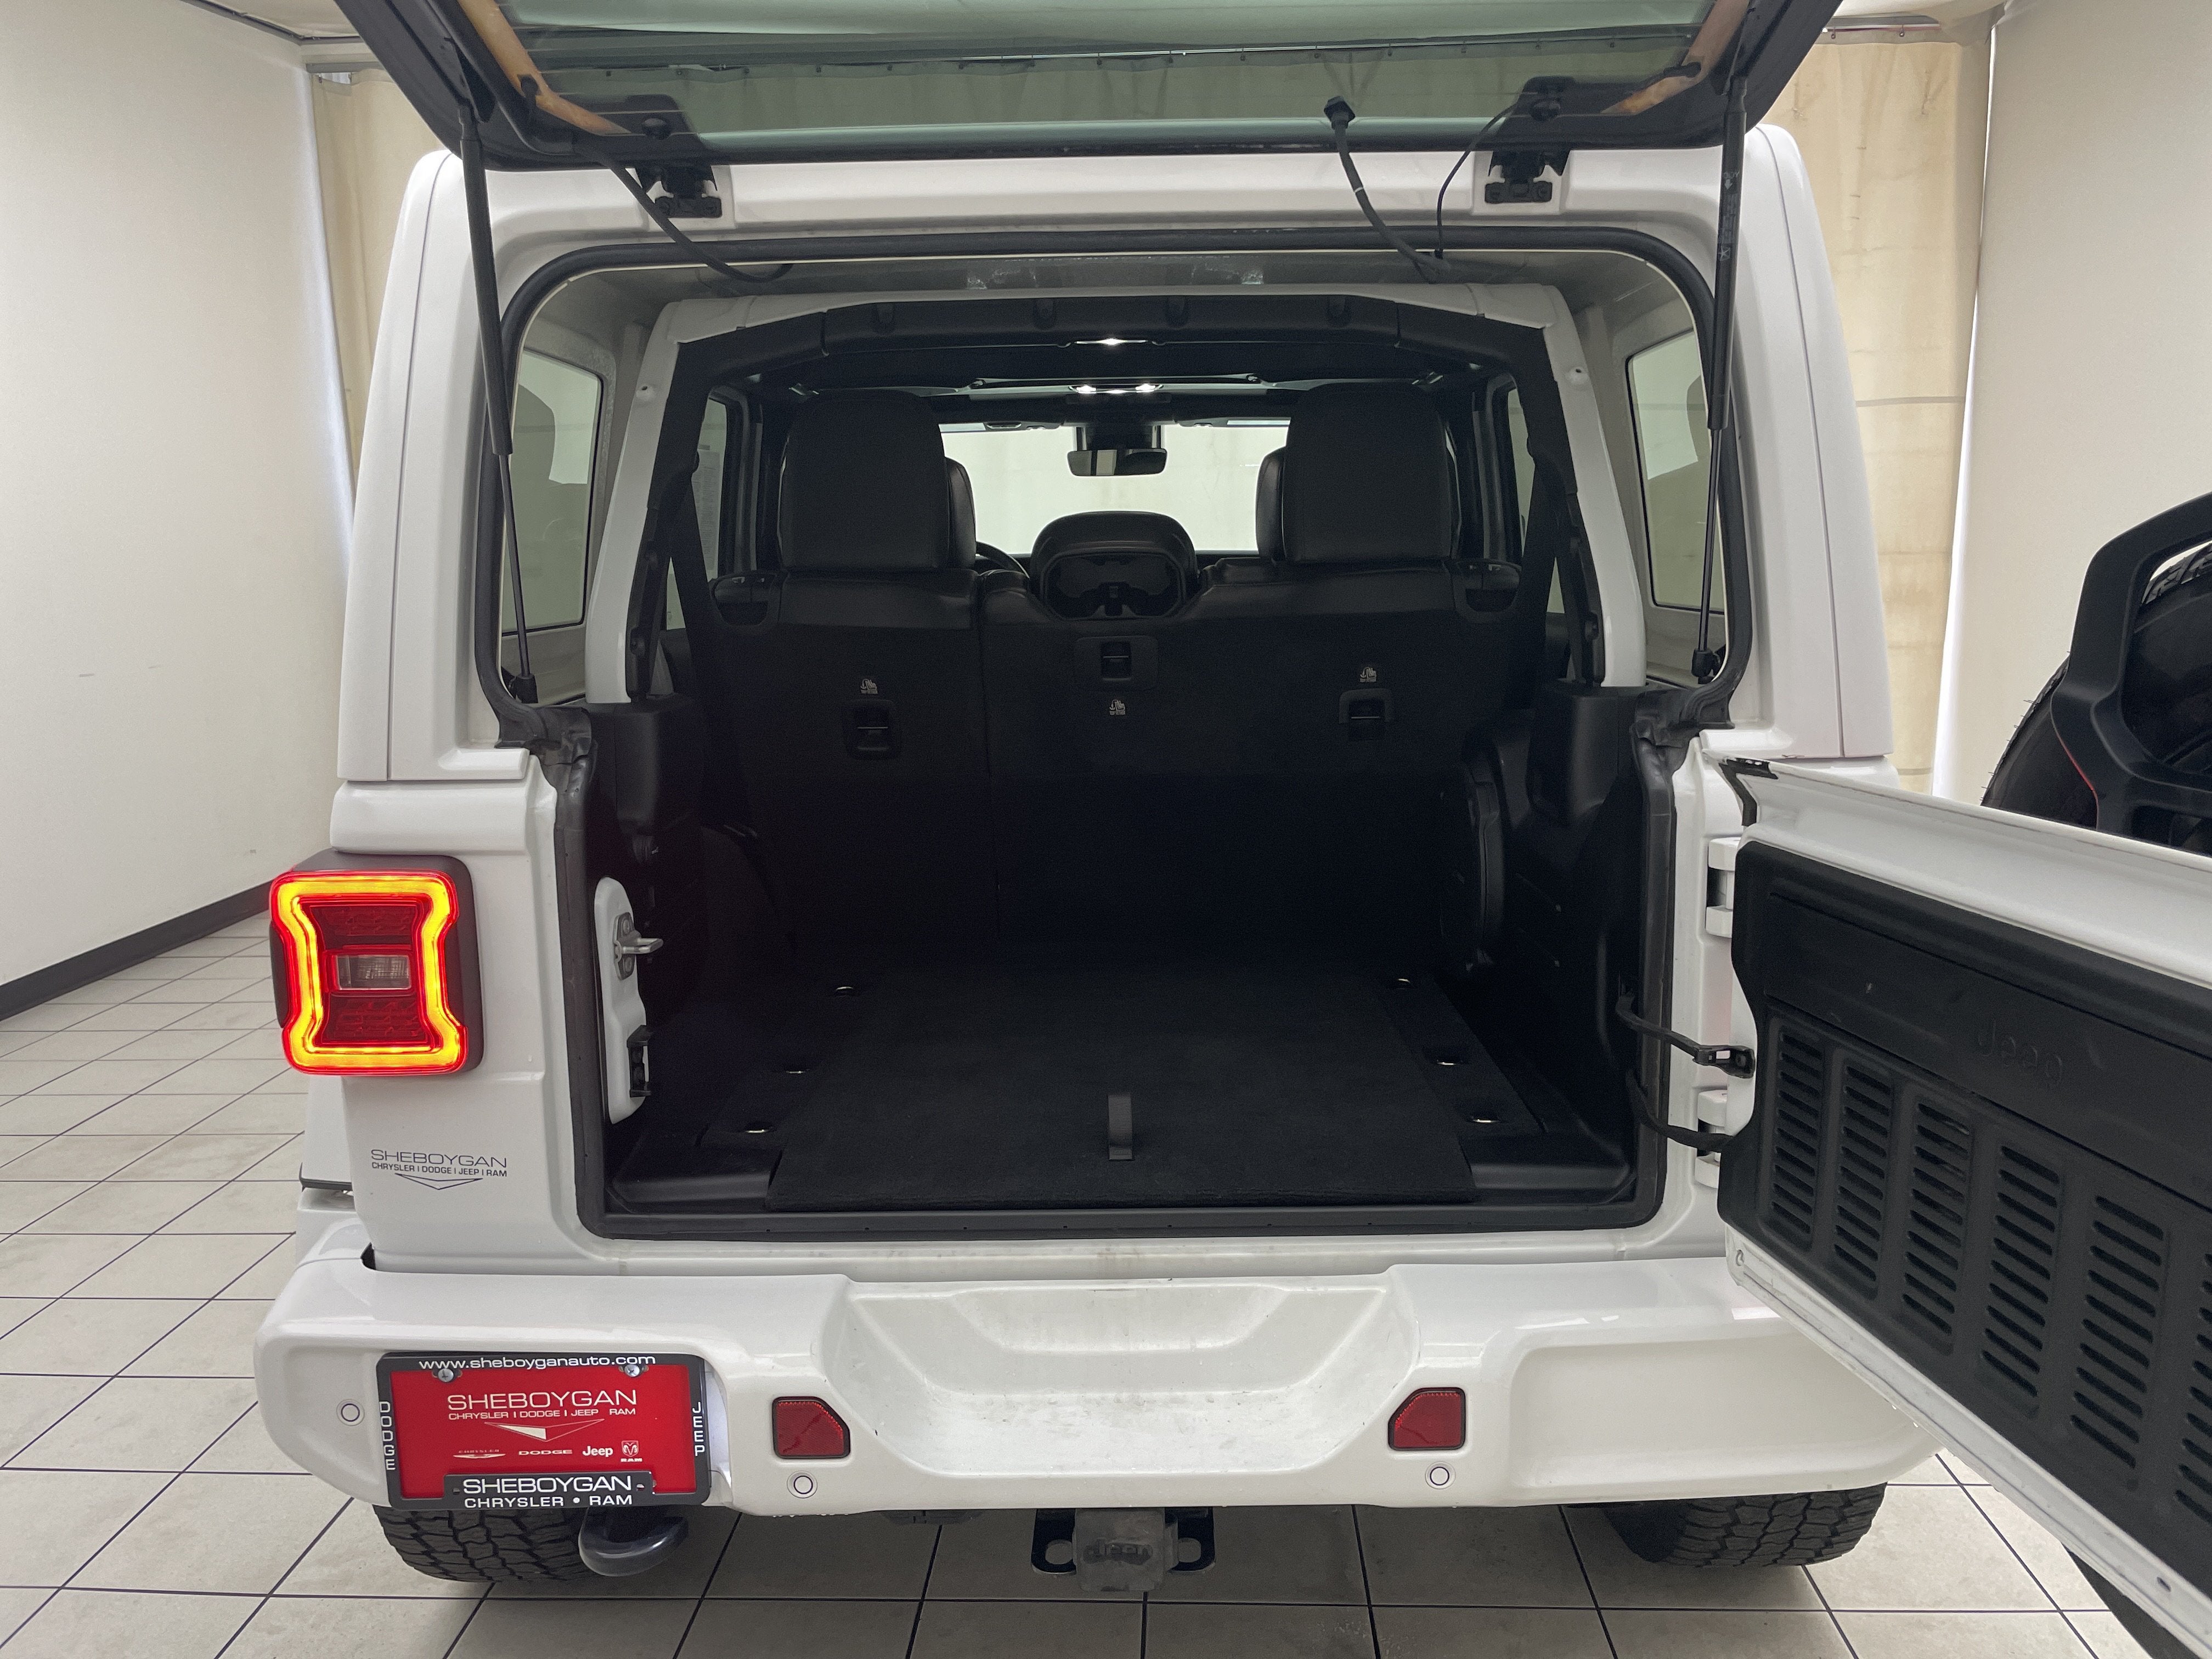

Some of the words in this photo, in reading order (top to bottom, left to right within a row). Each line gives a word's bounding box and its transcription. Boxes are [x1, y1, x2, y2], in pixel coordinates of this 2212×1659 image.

[371, 1149, 507, 1169] SHEBOYGAN
[371, 1161, 415, 1172] CHRYSLER
[421, 1165, 452, 1174] DODGE
[486, 1169, 507, 1177] RAM
[419, 1356, 656, 1370] www.sheboyganauto.com
[447, 1390, 637, 1410] SHEBOYGAN
[449, 1412, 509, 1420] CHRYSLER
[520, 1410, 560, 1418] DODGE
[379, 1401, 396, 1471] DODGE
[692, 1401, 706, 1457] JEEP
[582, 1446, 613, 1458] Jeep
[463, 1475, 631, 1494] SHEBOYGAN
[464, 1496, 564, 1508] CHRYSLER
[589, 1494, 633, 1506] RAM
